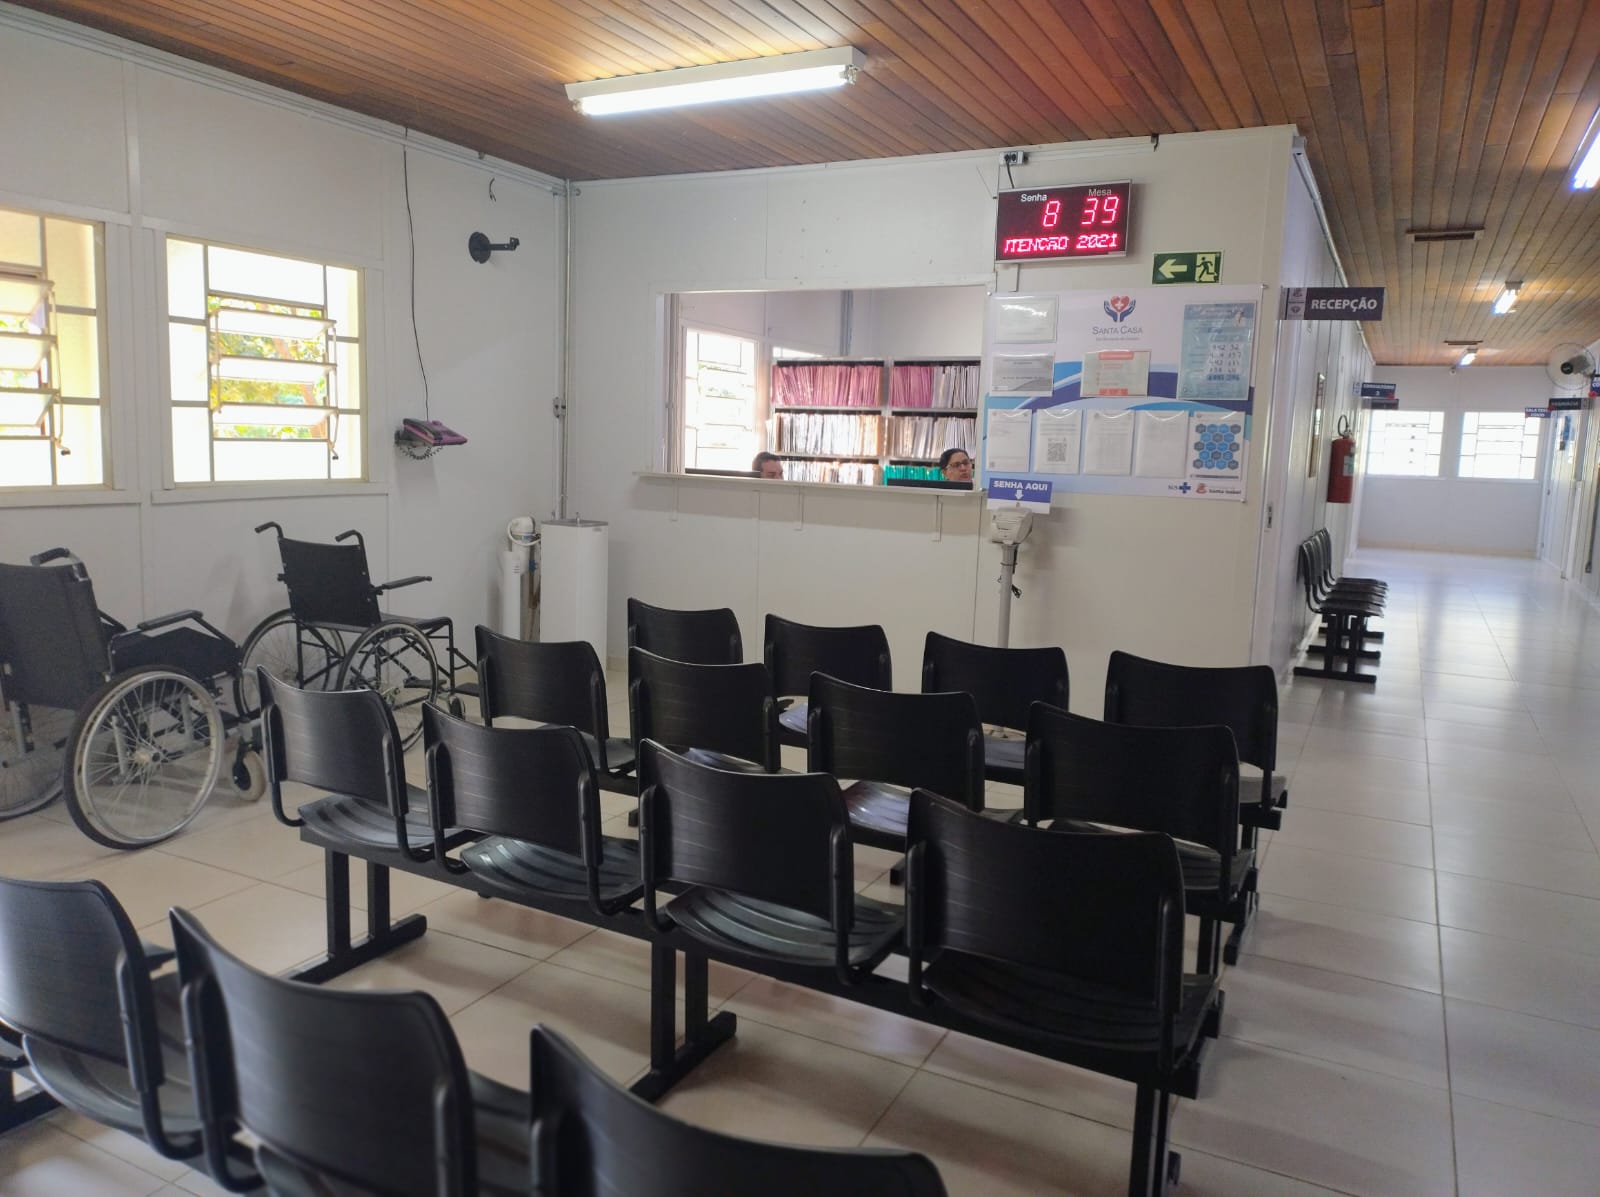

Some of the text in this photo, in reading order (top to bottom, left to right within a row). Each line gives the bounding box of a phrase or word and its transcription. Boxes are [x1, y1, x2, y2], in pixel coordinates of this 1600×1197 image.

[1021, 193, 1047, 202] Senha
[1088, 188, 1112, 197] Mesa
[1043, 200, 1060, 227] 8
[1081, 196, 1119, 225] 39
[1076, 233, 1118, 249] 2021
[1311, 297, 1378, 312] RECEPÇÃO
[1092, 325, 1144, 335] SANTA CASA
[993, 480, 1048, 491] SENHA AQUI
